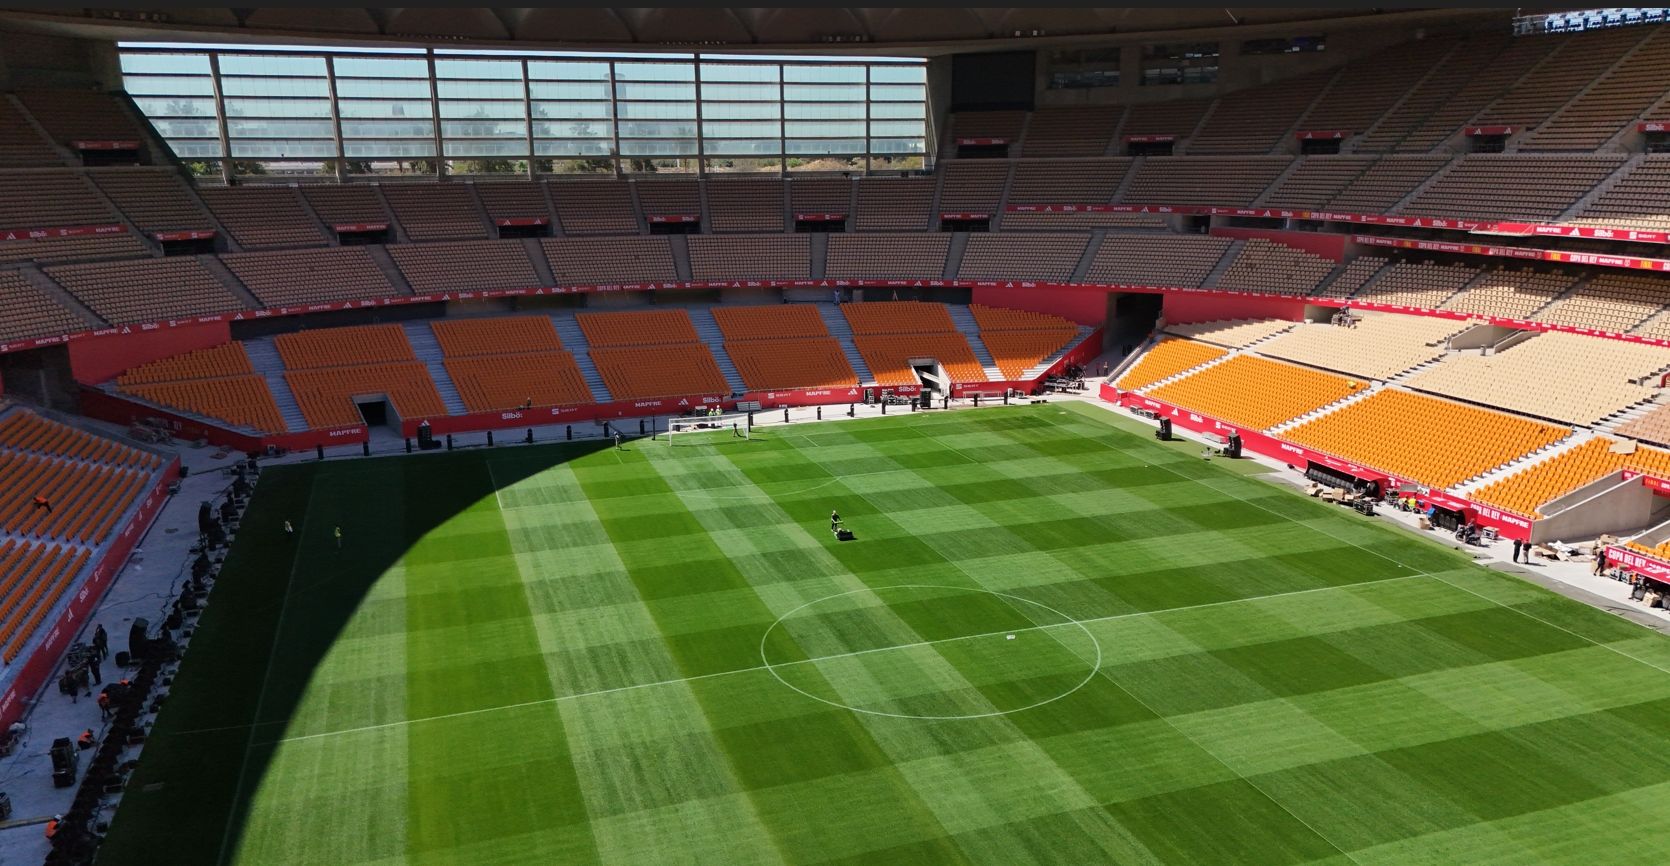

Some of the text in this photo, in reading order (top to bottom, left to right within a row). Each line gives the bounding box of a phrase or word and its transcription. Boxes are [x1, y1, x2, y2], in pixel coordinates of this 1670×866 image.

[329, 428, 362, 437] MAPFRE
[1501, 515, 1529, 528] MAPFRE
[1608, 549, 1647, 568] COPA DEL REY
